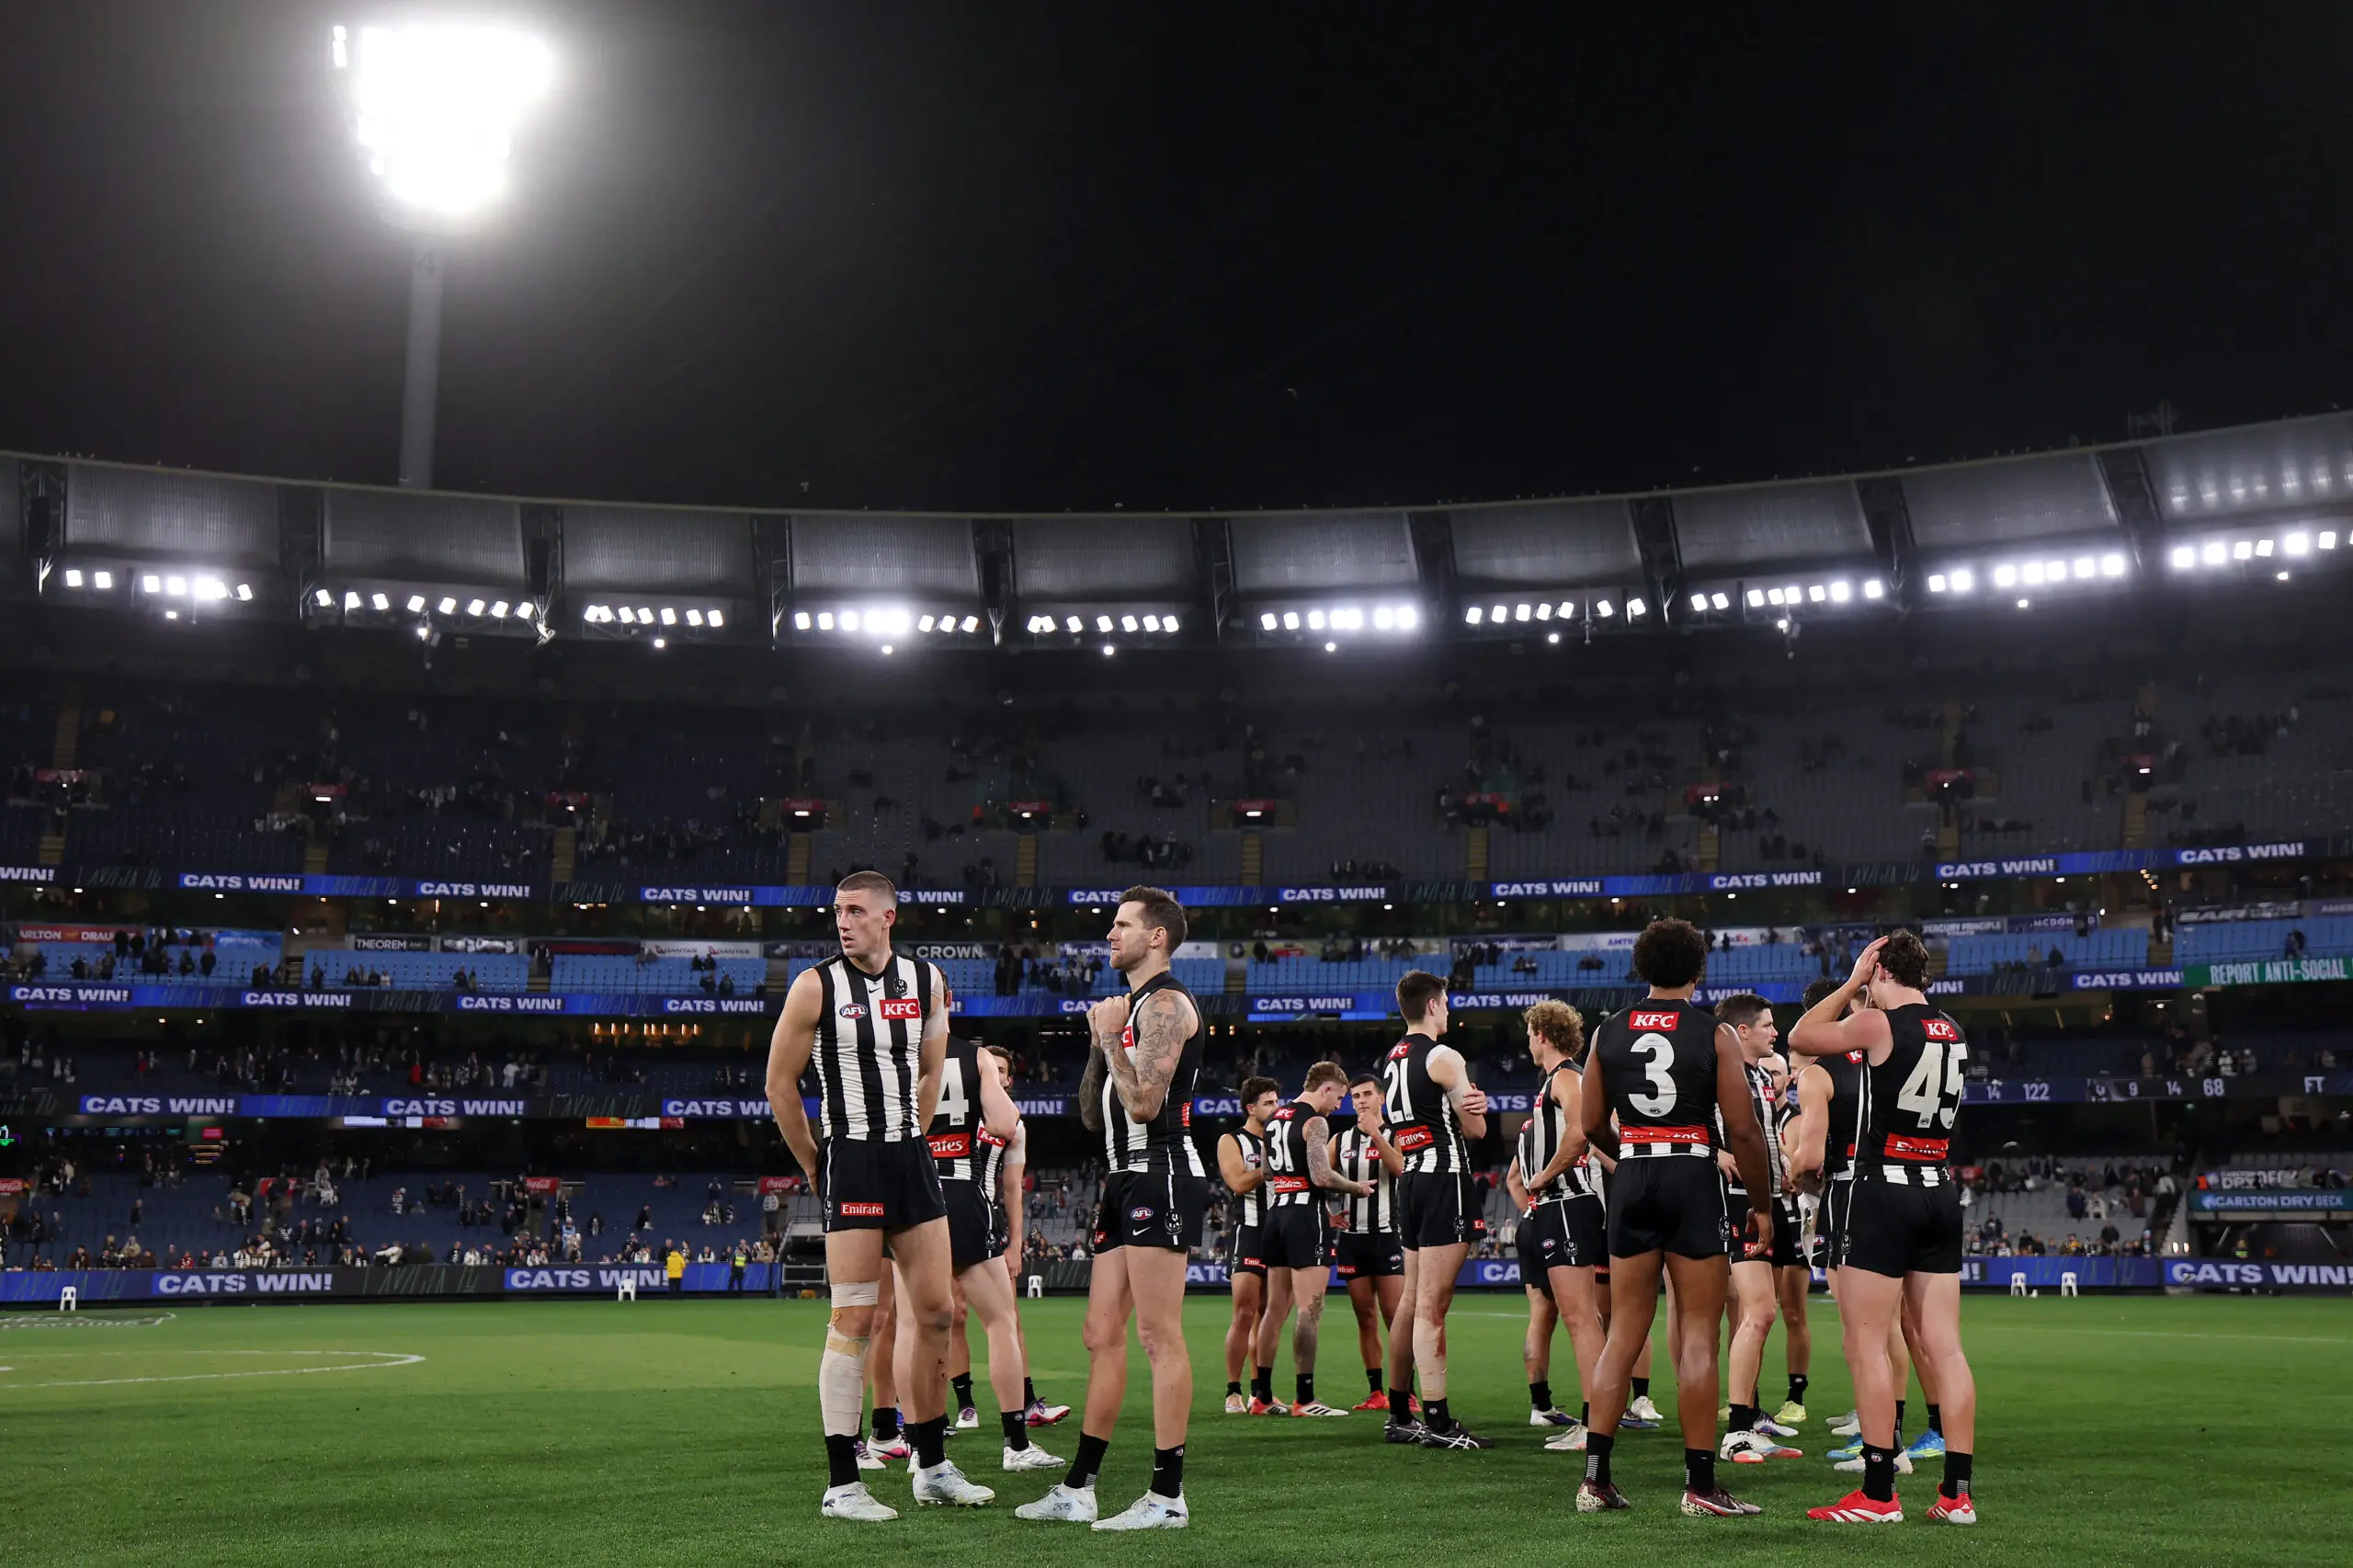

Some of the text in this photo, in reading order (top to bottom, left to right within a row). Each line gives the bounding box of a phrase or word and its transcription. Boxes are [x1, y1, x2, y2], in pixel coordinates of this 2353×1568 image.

[2180, 843, 2304, 863] CATS WIN!
[1939, 859, 2054, 878] CATS WIN!
[184, 874, 300, 891] CATS WIN!
[1713, 870, 1822, 889] CATS WIN!
[420, 882, 529, 897] CATS WIN!
[644, 888, 750, 902] CATS WIN!
[1283, 888, 1385, 901] CATS WIN!
[1495, 881, 1600, 896] CATS WIN!
[917, 892, 963, 903] WIN!
[356, 938, 406, 950] THEOREM
[916, 946, 983, 959] CROWN
[2211, 958, 2347, 984] REPORT ANTI-SOCIAL
[2076, 974, 2131, 988] CATS
[14, 987, 129, 1002] CATS WIN!
[245, 993, 351, 1006] CATS WIN!
[1453, 994, 1501, 1007] CATS
[460, 996, 561, 1010] CATS WIN!
[666, 998, 764, 1012] CATS WIN!
[884, 1003, 916, 1015] KFC
[1256, 998, 1351, 1011] CATS WIN!
[843, 1006, 865, 1016] AFL
[1633, 1015, 1675, 1028] KFC
[1390, 1045, 1407, 1057] FC
[1629, 1033, 1677, 1118] 3
[1383, 1058, 1415, 1124] 21
[1897, 1041, 1968, 1130] 45
[2023, 1084, 2050, 1100] 122
[2129, 1079, 2224, 1096] 9 14 68
[2303, 1076, 2325, 1094] FT
[85, 1098, 234, 1113] CATS WIN!
[387, 1100, 524, 1115] CATS WIN!
[666, 1100, 732, 1116] CATS
[1199, 1099, 1242, 1114] CAT
[1487, 1095, 1528, 1110] ATS
[929, 1140, 963, 1152] rates
[1266, 1119, 1294, 1172] 31
[2216, 1196, 2278, 1207] CARLTON
[2280, 1195, 2313, 1207] DRY
[842, 1204, 883, 1214] Emirates
[1132, 1210, 1151, 1218] AFL
[511, 1270, 590, 1289] CATS
[1483, 1264, 1520, 1281] CA
[2172, 1263, 2263, 1284] CATS
[158, 1273, 333, 1294] CATS WIN!
